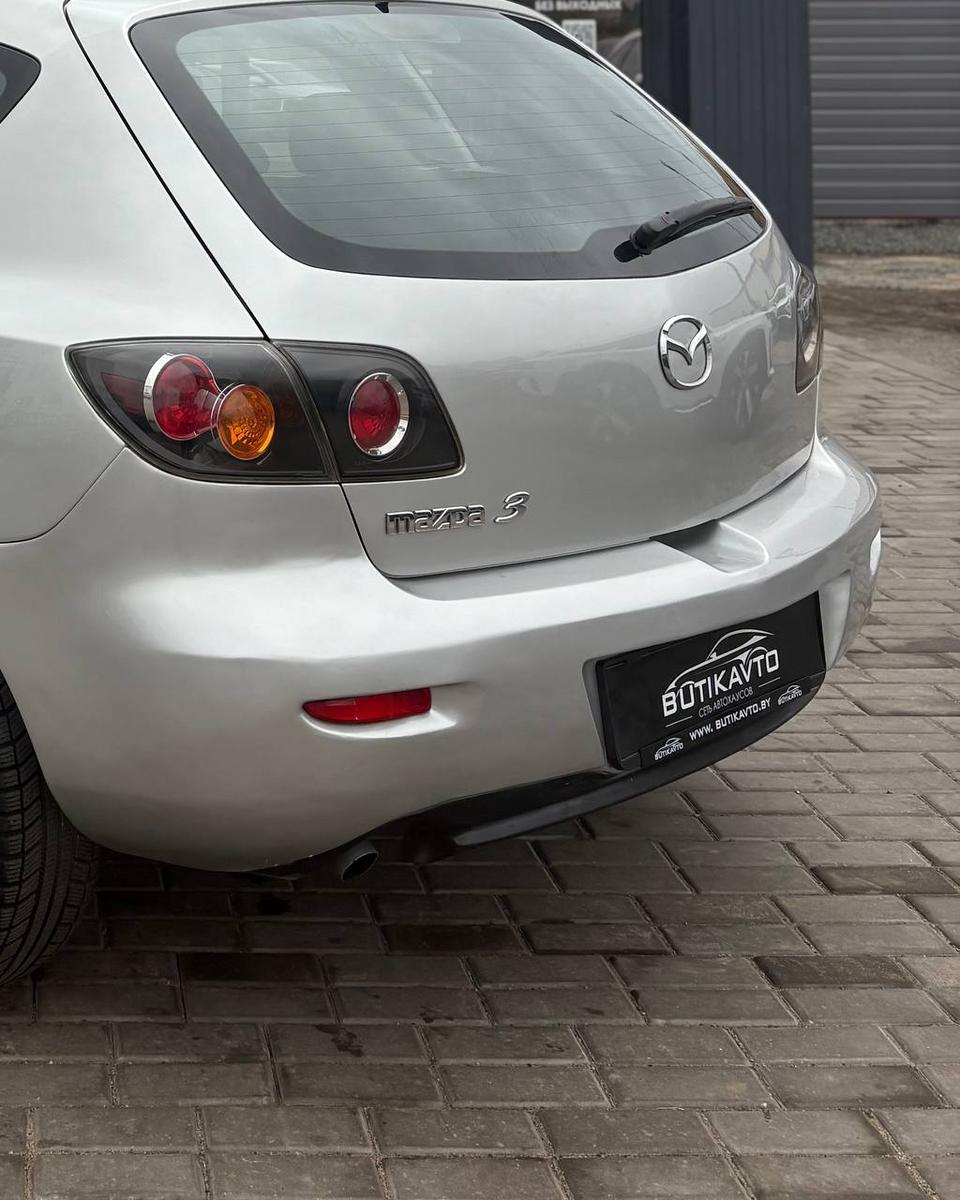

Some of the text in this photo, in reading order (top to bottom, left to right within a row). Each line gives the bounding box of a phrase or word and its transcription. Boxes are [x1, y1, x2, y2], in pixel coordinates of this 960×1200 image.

[493, 490, 531, 524] 3
[661, 648, 780, 717] BUTIKAVTO
[689, 697, 772, 742] WWW. BUTIKAVTO.BY
[698, 686, 754, 719] СЕТЬ АВТОХАУСОВ
[654, 741, 684, 761] BUTIKAVTO
